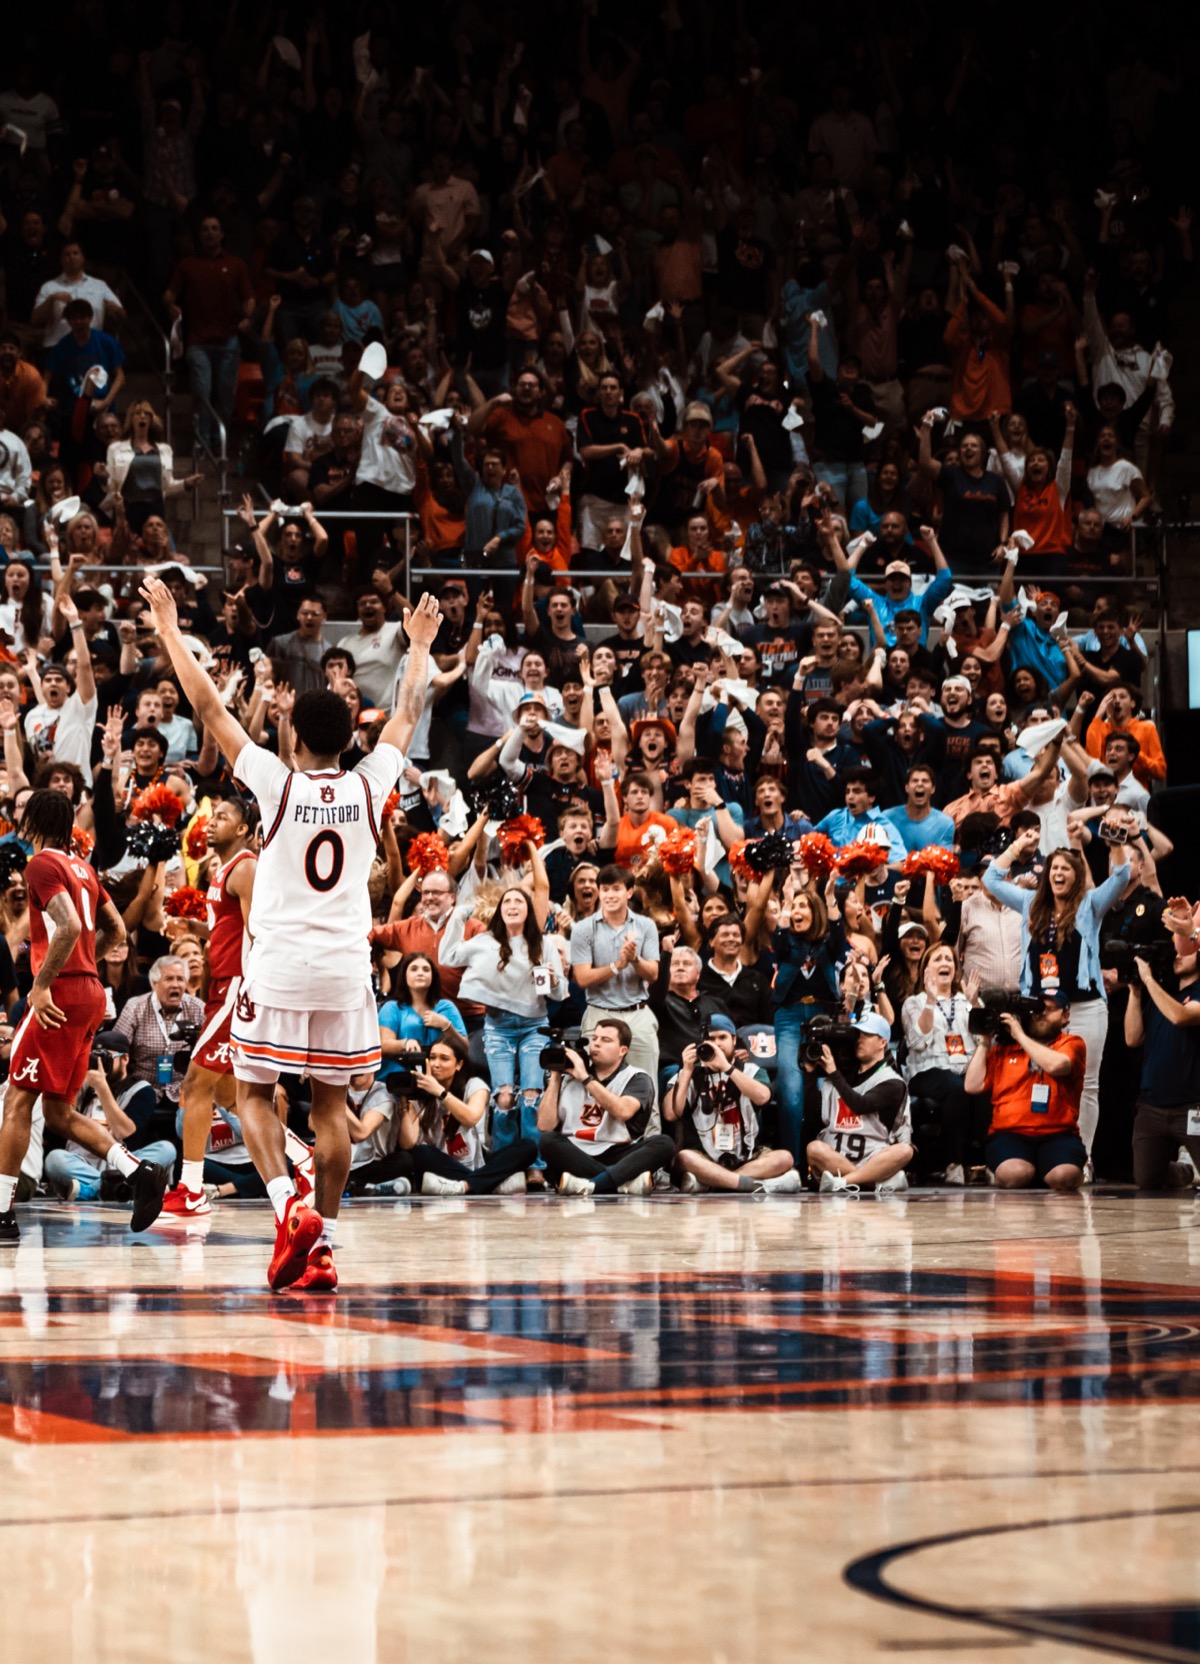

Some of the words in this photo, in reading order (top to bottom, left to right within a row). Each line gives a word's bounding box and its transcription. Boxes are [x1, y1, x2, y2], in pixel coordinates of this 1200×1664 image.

[294, 804, 360, 824] PETTIFORD
[303, 827, 345, 893] 0
[834, 1132, 866, 1163] 19
